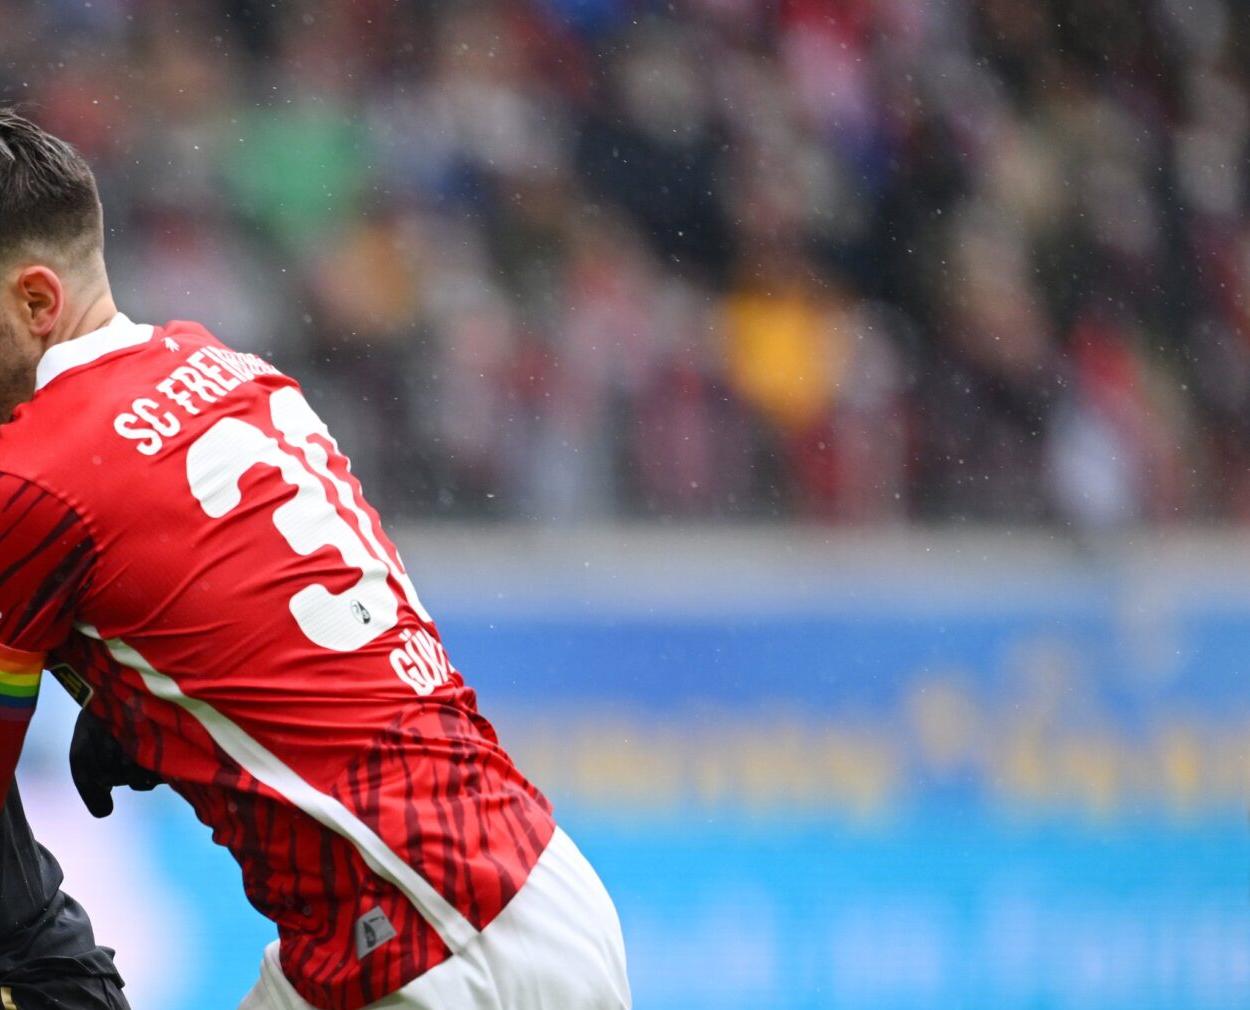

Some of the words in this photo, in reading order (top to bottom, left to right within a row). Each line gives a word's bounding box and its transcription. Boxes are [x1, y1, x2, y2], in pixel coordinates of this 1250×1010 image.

[113, 397, 181, 456] SC
[155, 345, 282, 416] FREI
[389, 627, 456, 696] GÜN
